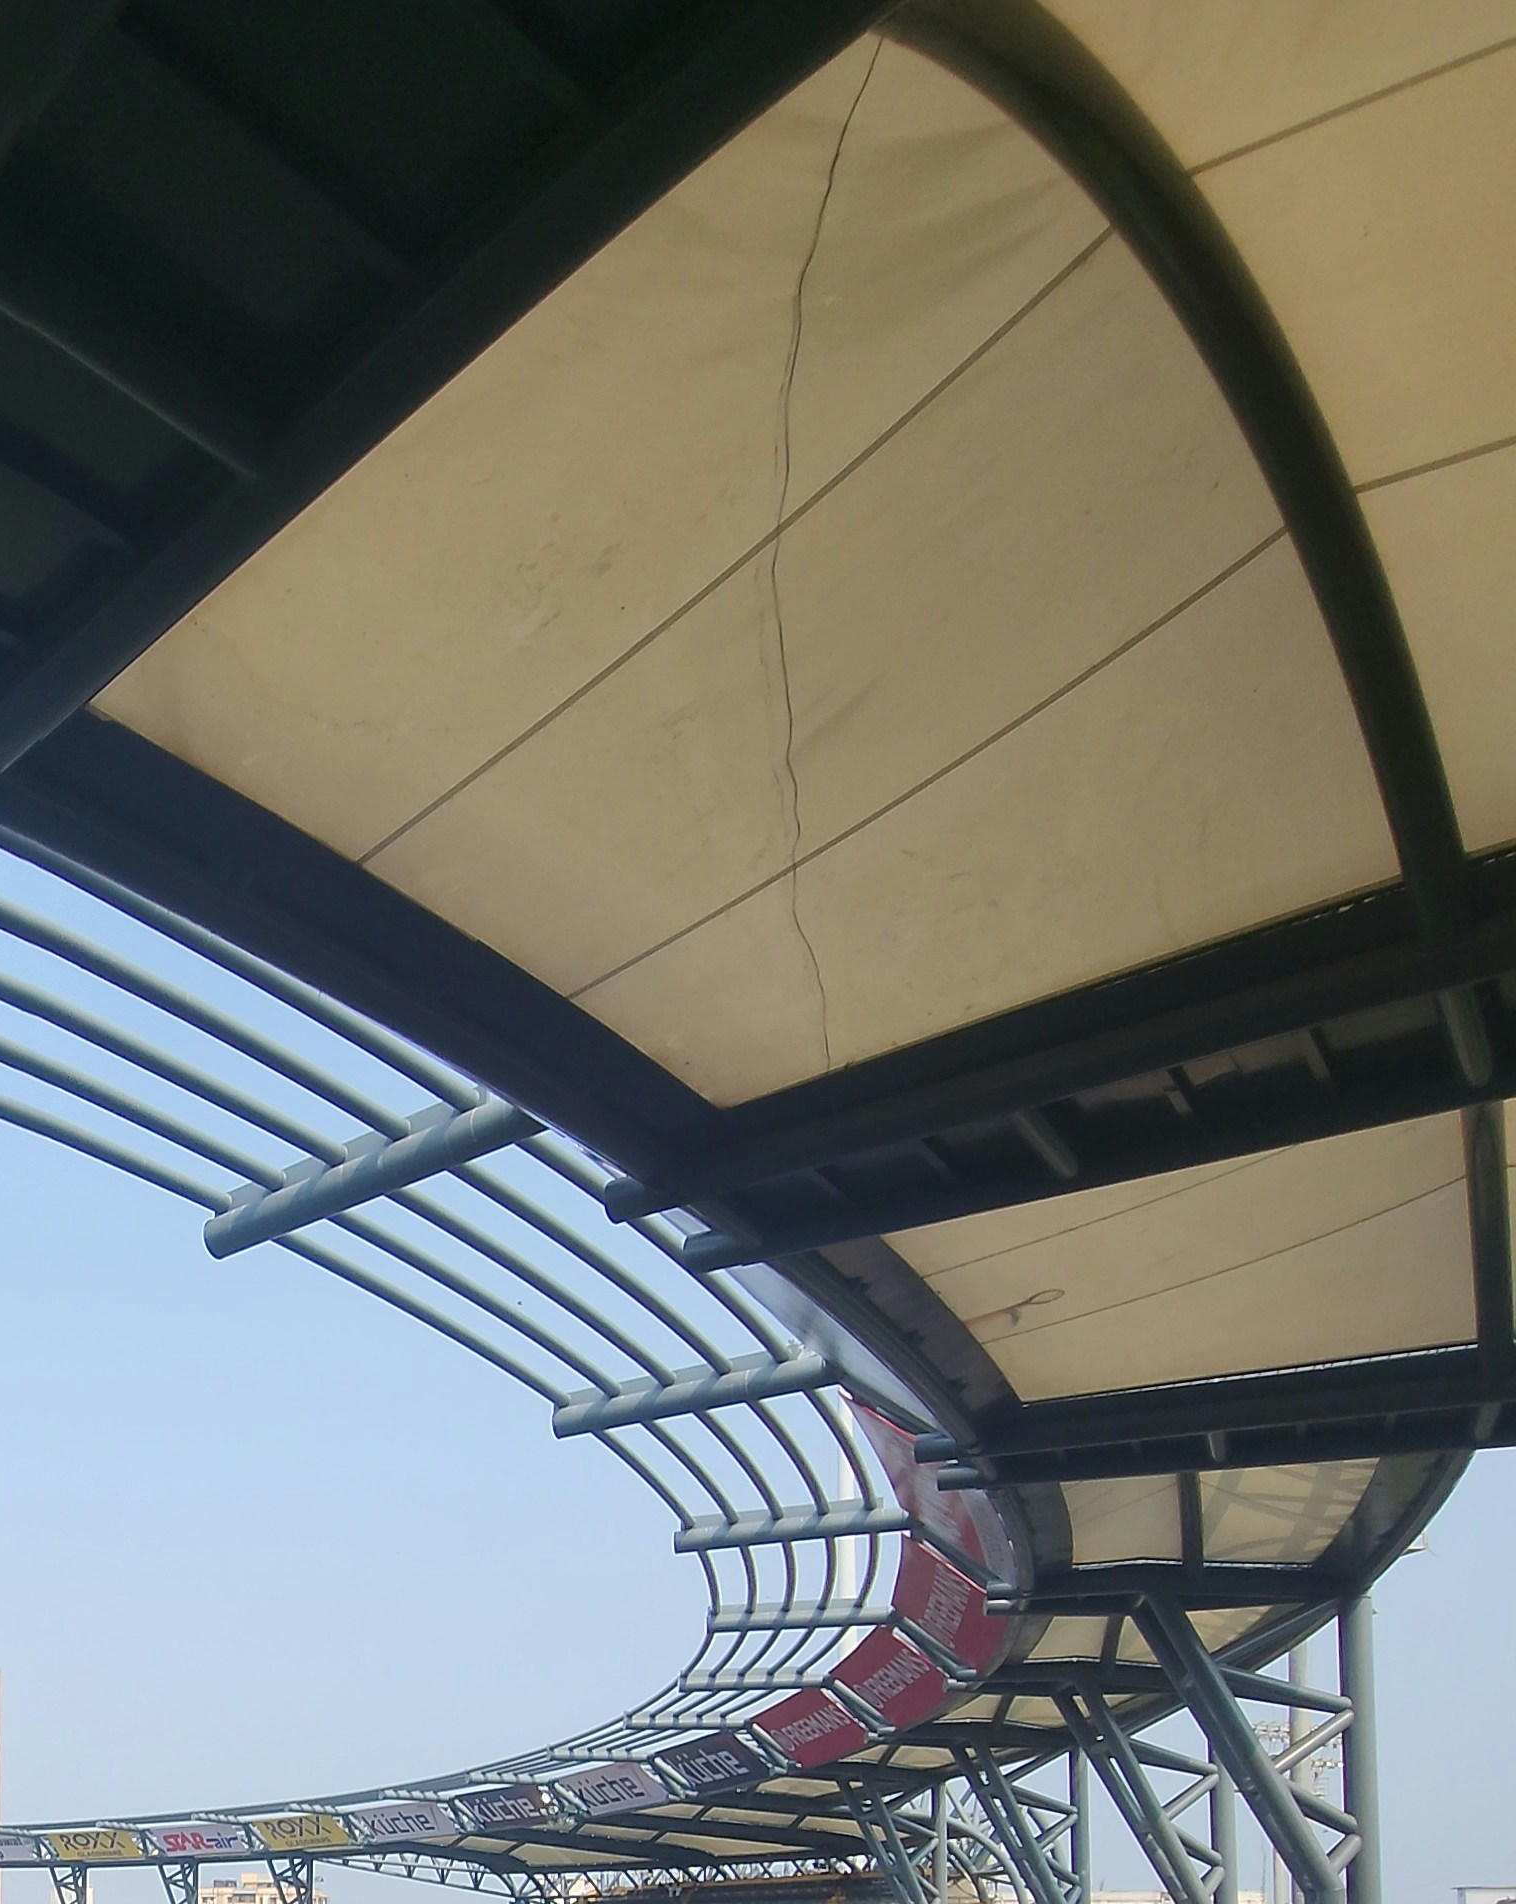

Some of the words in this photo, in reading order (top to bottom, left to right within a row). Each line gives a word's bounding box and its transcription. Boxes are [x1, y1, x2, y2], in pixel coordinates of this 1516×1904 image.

[868, 1648, 930, 1705] FREEMANS
[790, 1703, 852, 1747] FREEMANS
[679, 1747, 748, 1785] küche
[572, 1774, 645, 1808] küche
[474, 1794, 539, 1822] küche
[265, 1816, 331, 1838] ROXX
[370, 1812, 435, 1836] küche
[60, 1831, 125, 1851] ROXX
